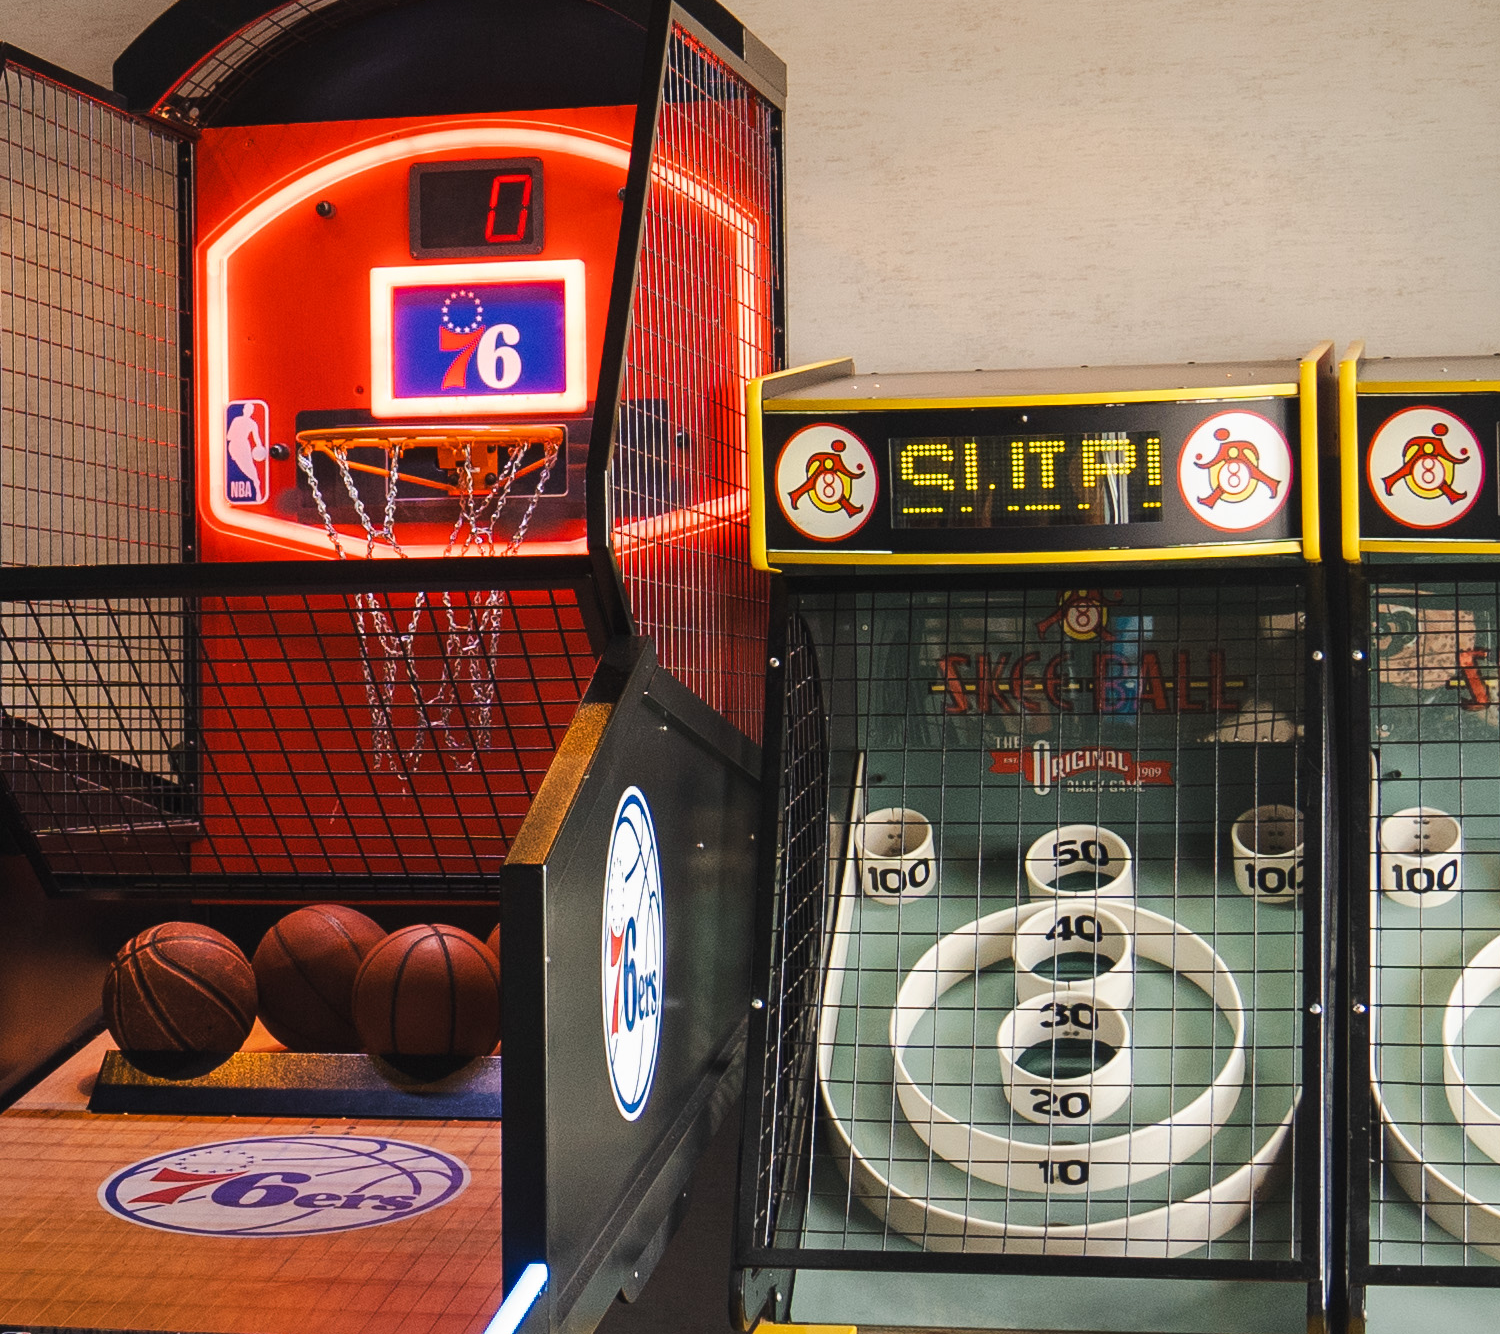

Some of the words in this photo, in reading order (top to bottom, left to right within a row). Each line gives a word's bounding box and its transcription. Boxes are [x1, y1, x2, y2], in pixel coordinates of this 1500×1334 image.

[484, 174, 533, 244] 0
[439, 322, 522, 390] 76
[229, 479, 254, 500] NBA
[1052, 840, 1109, 867] 50
[867, 858, 930, 894] 100
[1392, 859, 1459, 894] 100
[1045, 915, 1104, 944] 40
[610, 916, 658, 1038] 76ers
[1039, 1002, 1099, 1032] 30
[1030, 1088, 1091, 1119] 20
[1038, 1159, 1090, 1186] 10
[126, 1166, 415, 1214] 76ers
